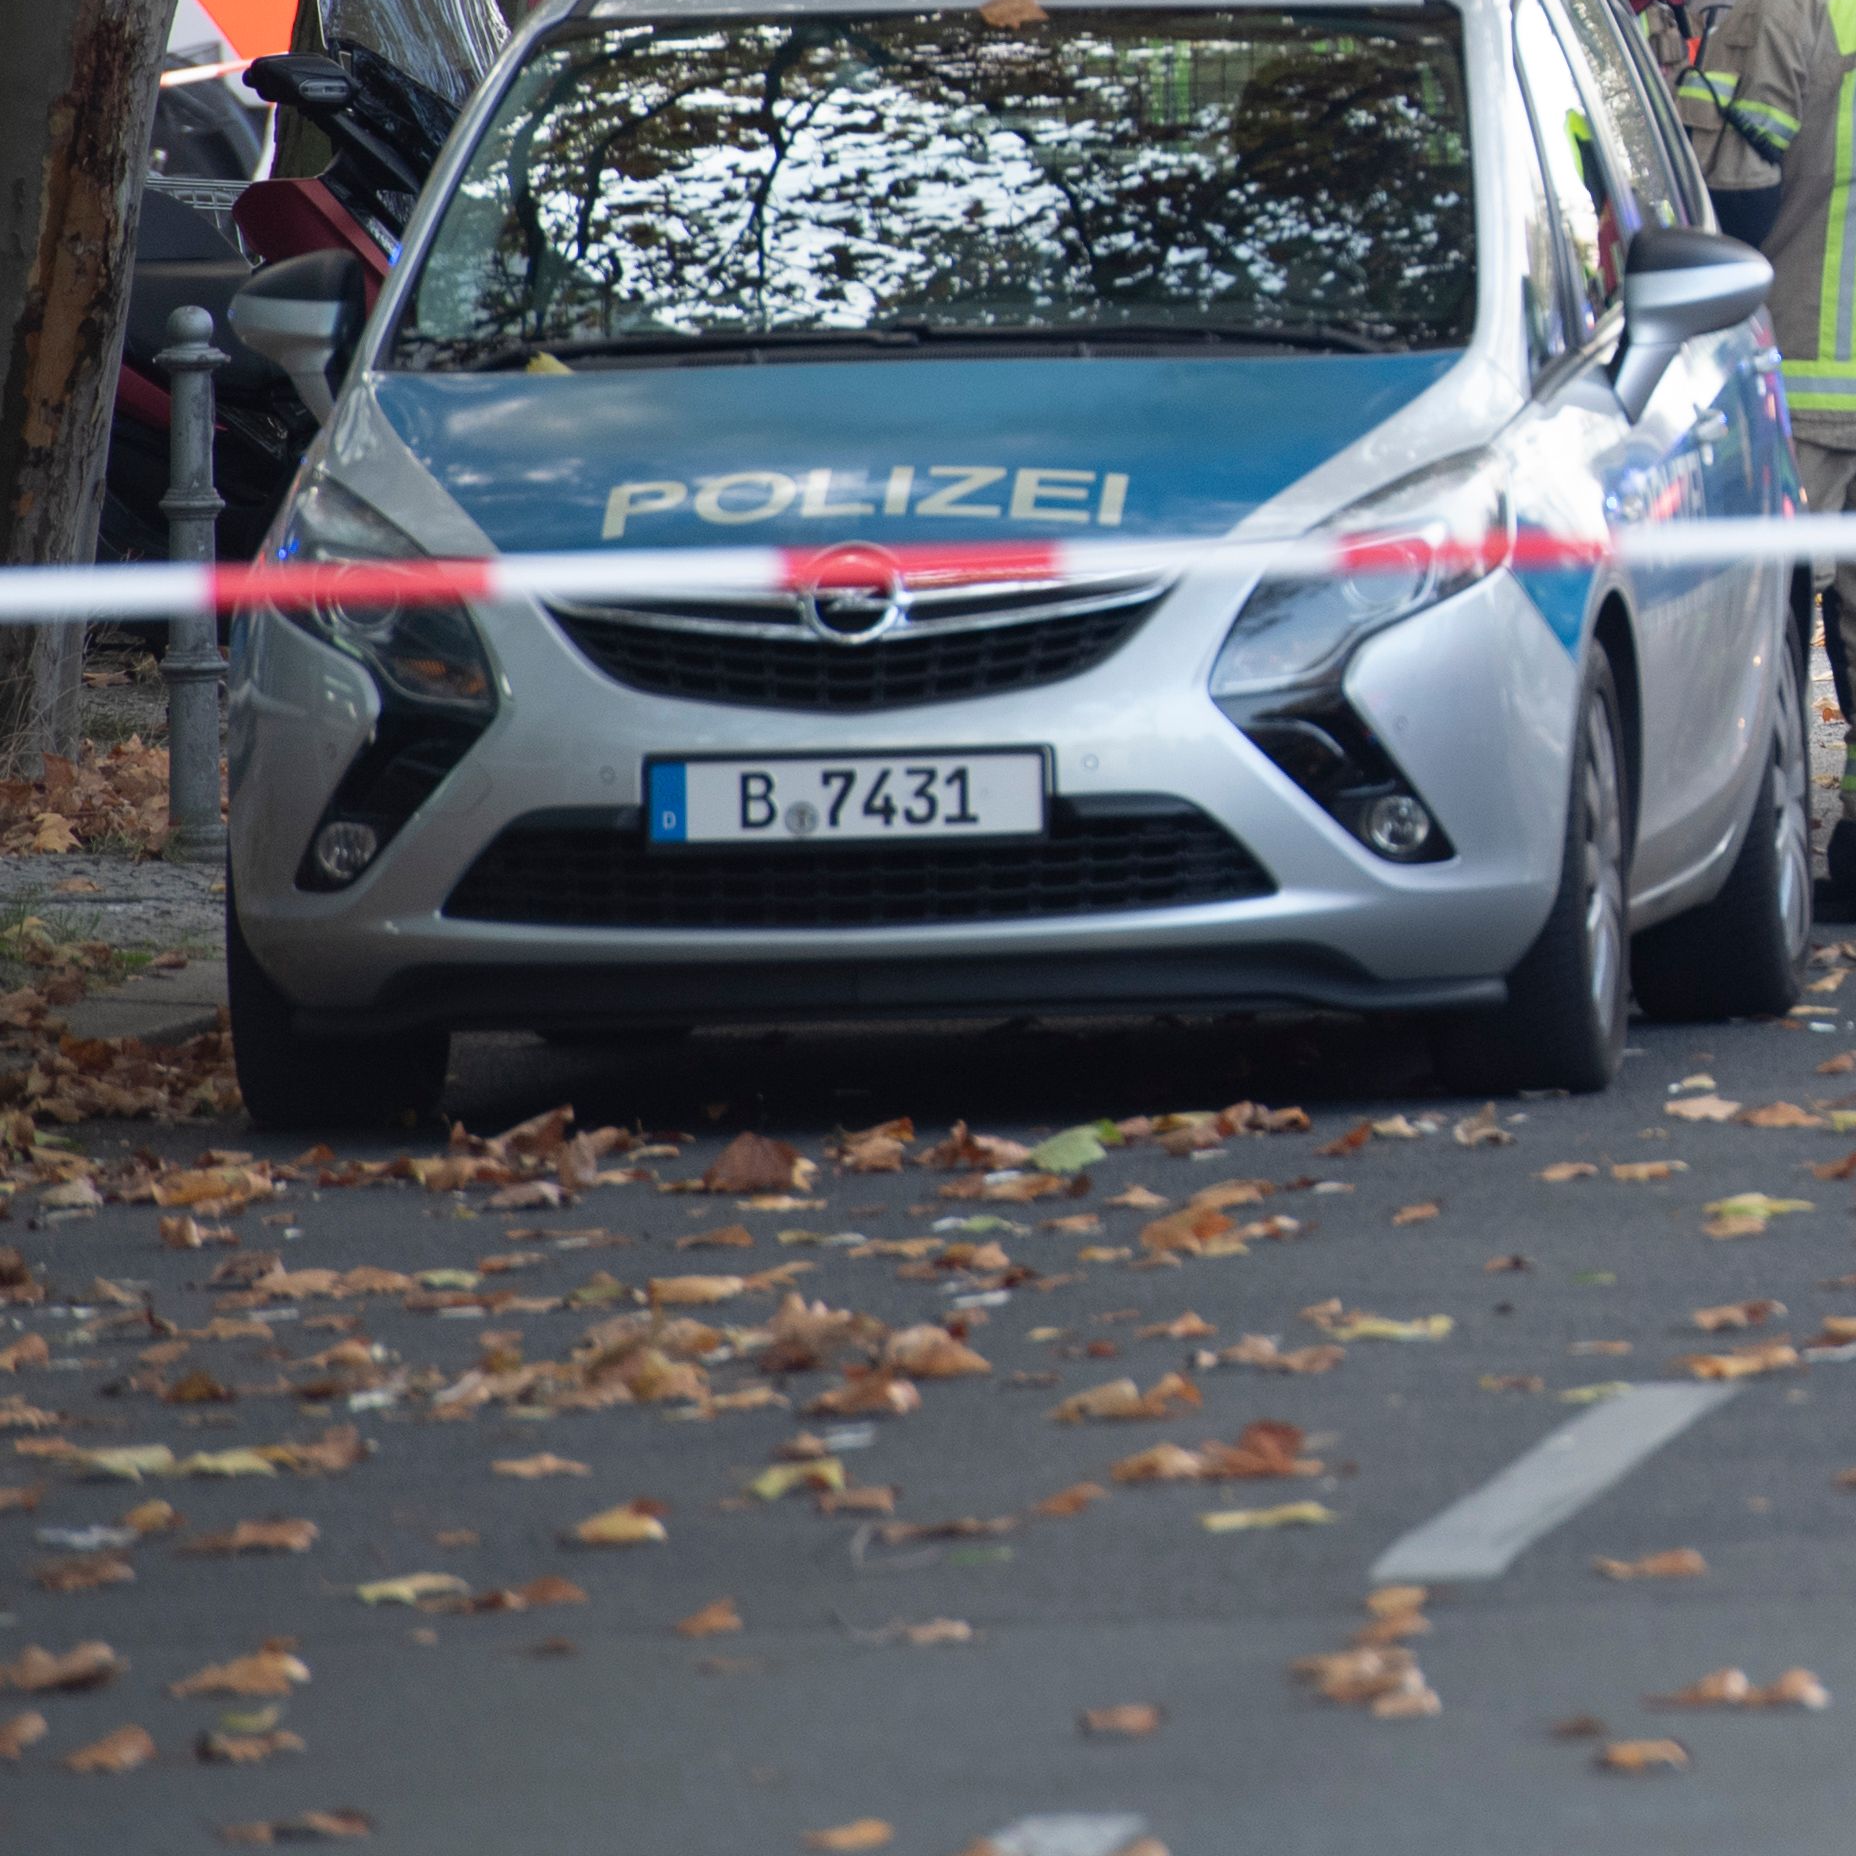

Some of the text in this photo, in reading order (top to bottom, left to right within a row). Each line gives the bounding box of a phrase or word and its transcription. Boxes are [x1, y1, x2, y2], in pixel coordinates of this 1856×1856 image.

[601, 464, 1129, 541] POLIZEI
[662, 767, 979, 831] D B 7431
